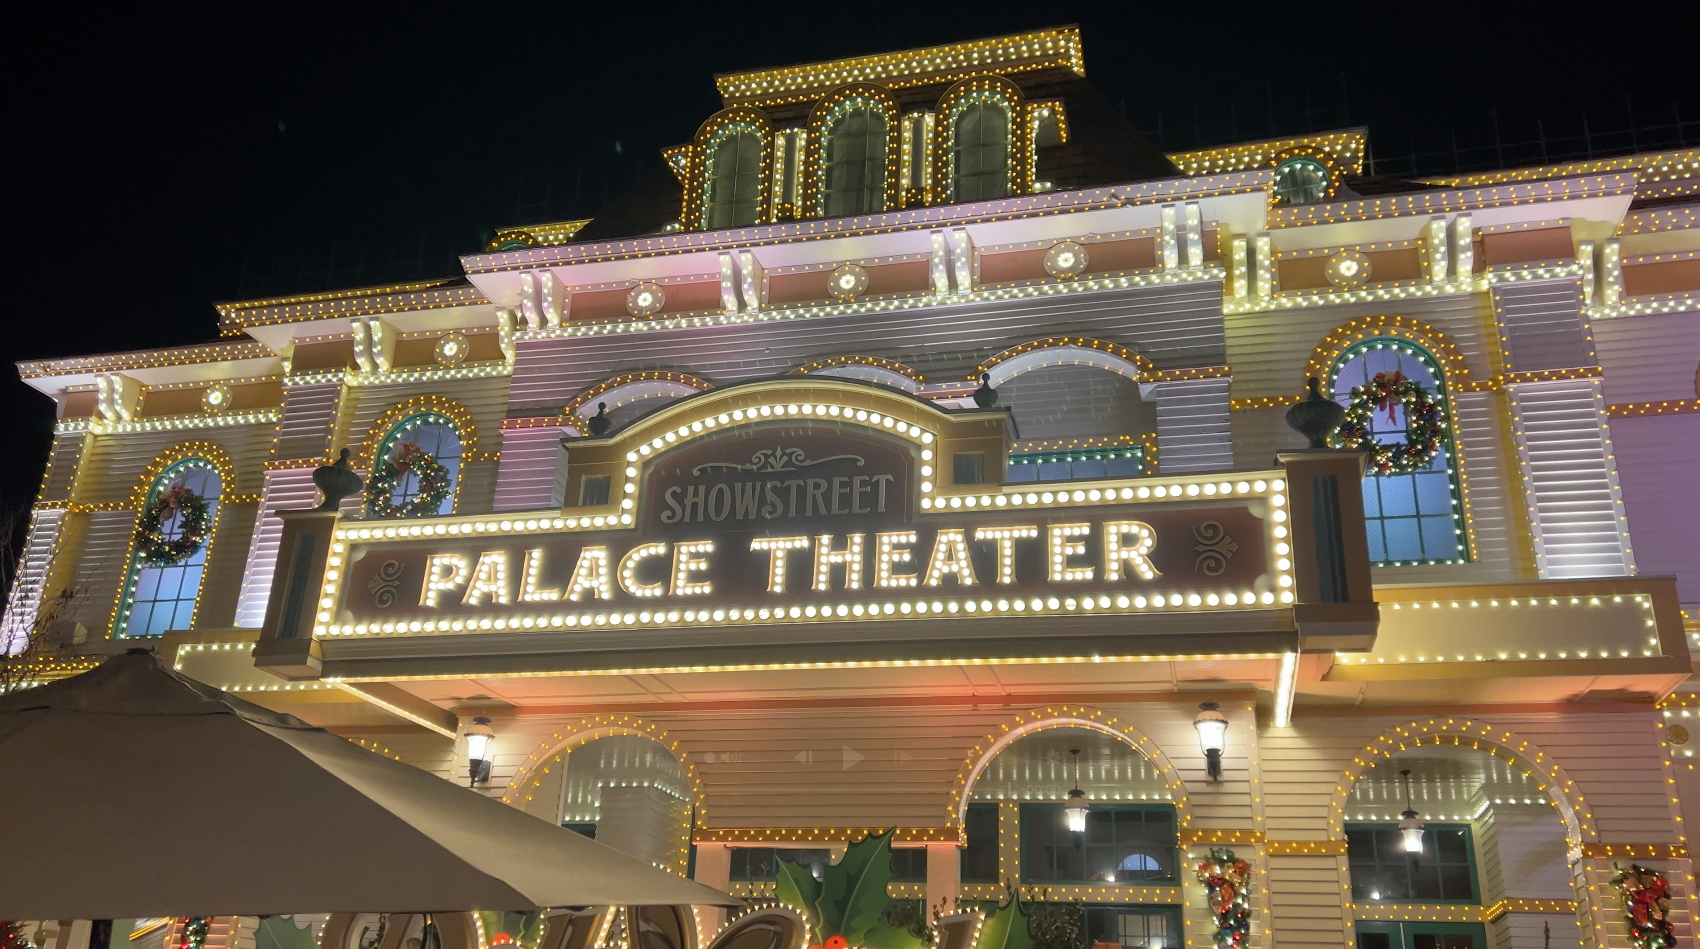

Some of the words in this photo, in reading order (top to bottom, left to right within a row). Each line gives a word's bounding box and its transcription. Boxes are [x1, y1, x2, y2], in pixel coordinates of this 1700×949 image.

[660, 474, 895, 524] SHOWSTREET
[418, 540, 713, 607] PALACE
[750, 520, 1164, 593] THEATER
